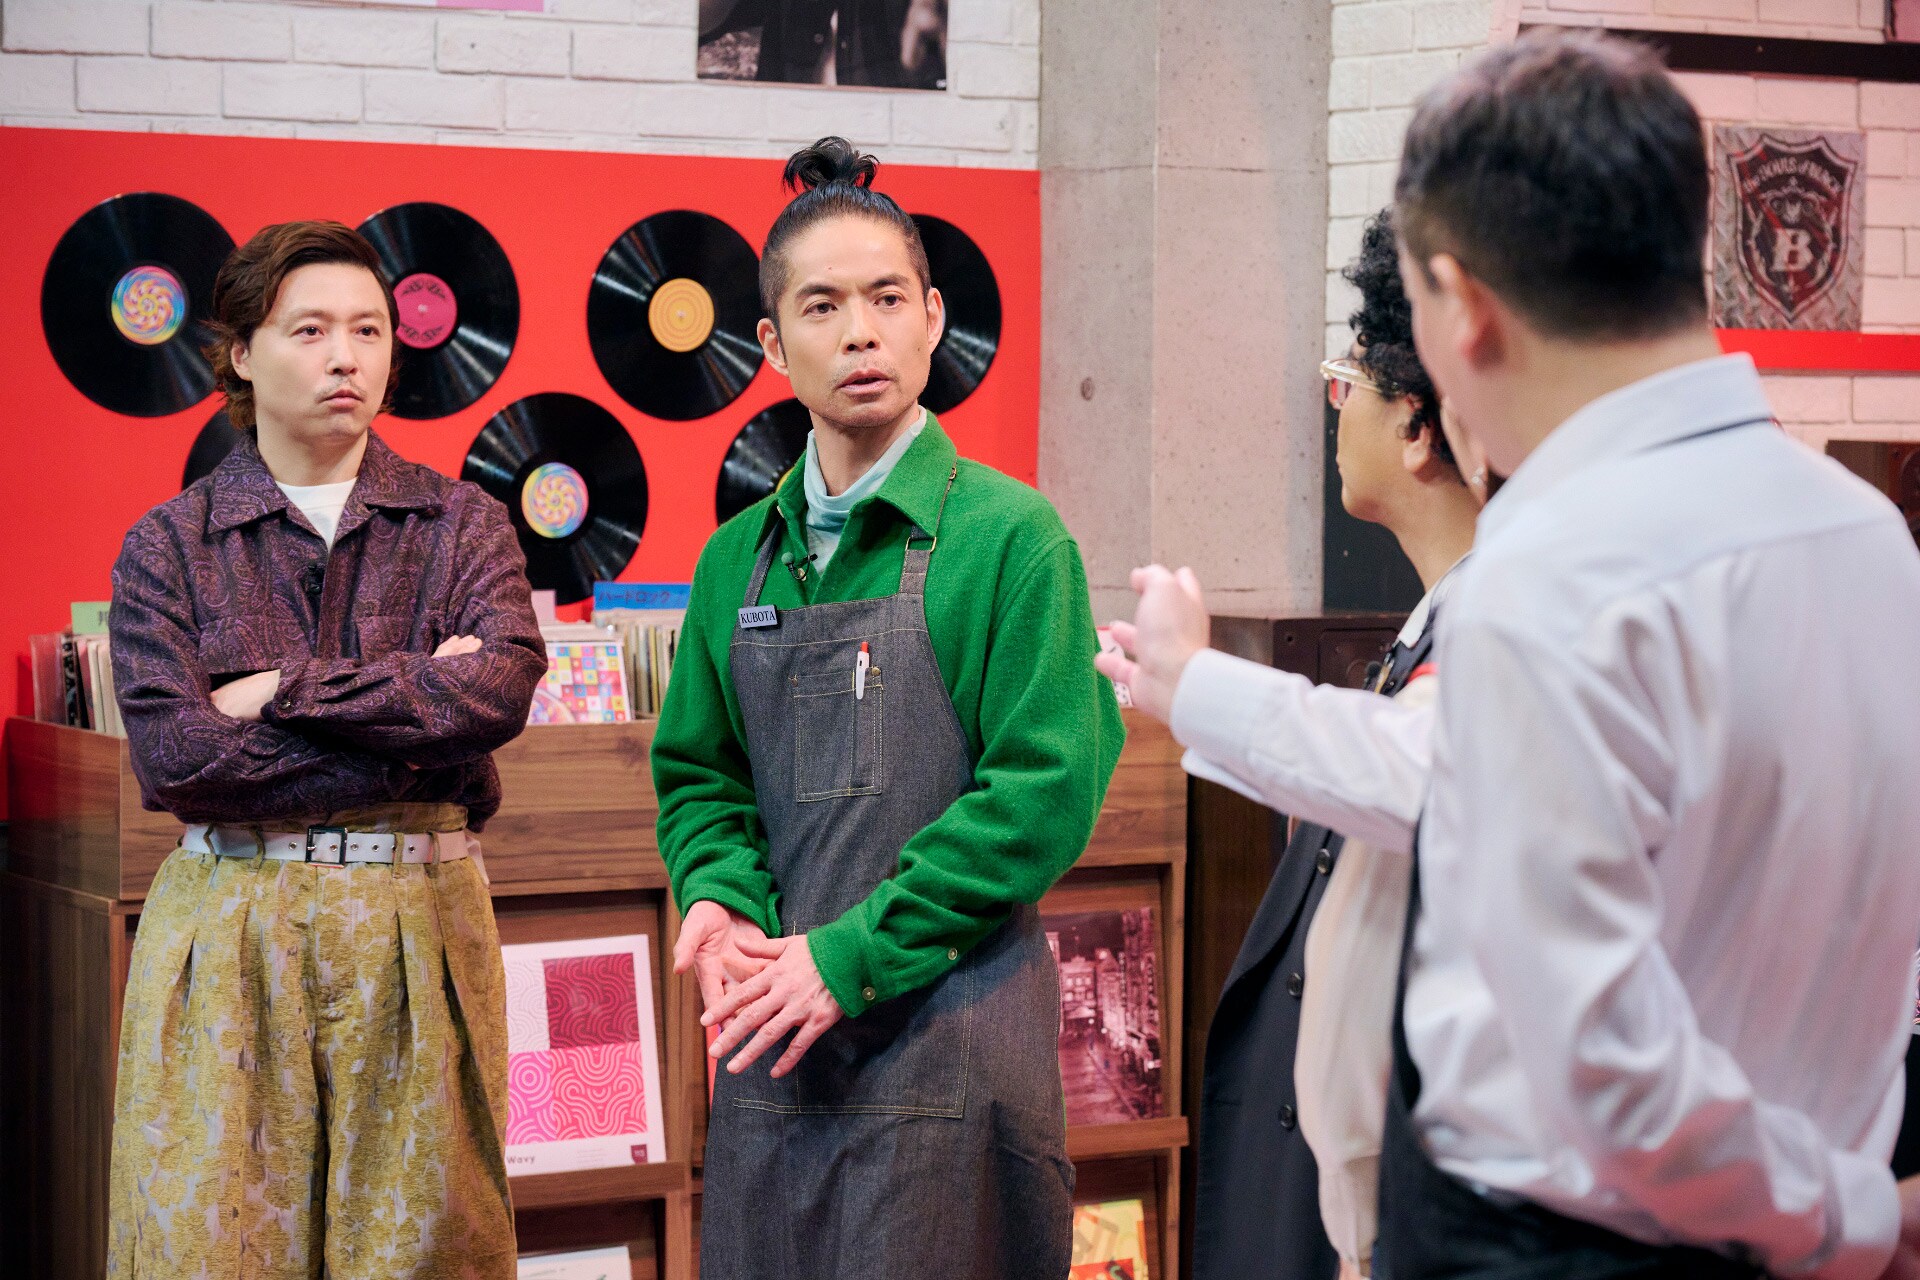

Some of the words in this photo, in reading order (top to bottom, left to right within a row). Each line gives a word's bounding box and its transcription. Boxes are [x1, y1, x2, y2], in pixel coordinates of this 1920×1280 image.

[1770, 228, 1814, 273] B
[598, 588, 670, 604] ハードロック
[740, 611, 776, 624] KUBOTA
[506, 1155, 535, 1165] Wavy
